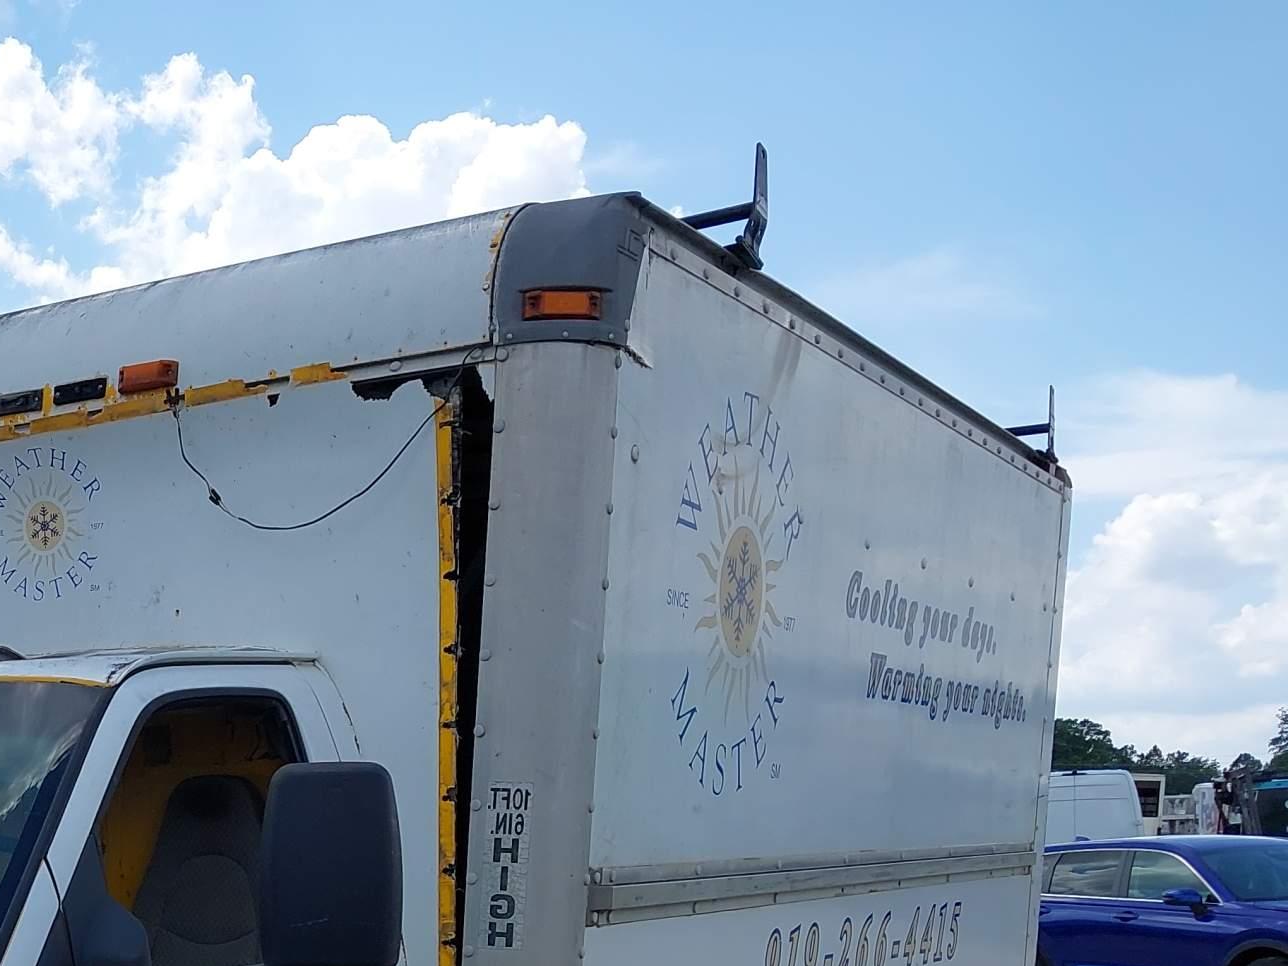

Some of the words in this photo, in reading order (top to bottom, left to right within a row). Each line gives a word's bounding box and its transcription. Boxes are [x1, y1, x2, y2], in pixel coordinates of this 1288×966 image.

[676, 391, 804, 561] WEATHER
[667, 588, 690, 609] SINCE
[783, 615, 796, 633] 1977
[846, 570, 919, 647] Cooling
[919, 604, 959, 649] your
[866, 652, 943, 721] Warming
[942, 680, 980, 723] your
[670, 665, 786, 797] MASTER
